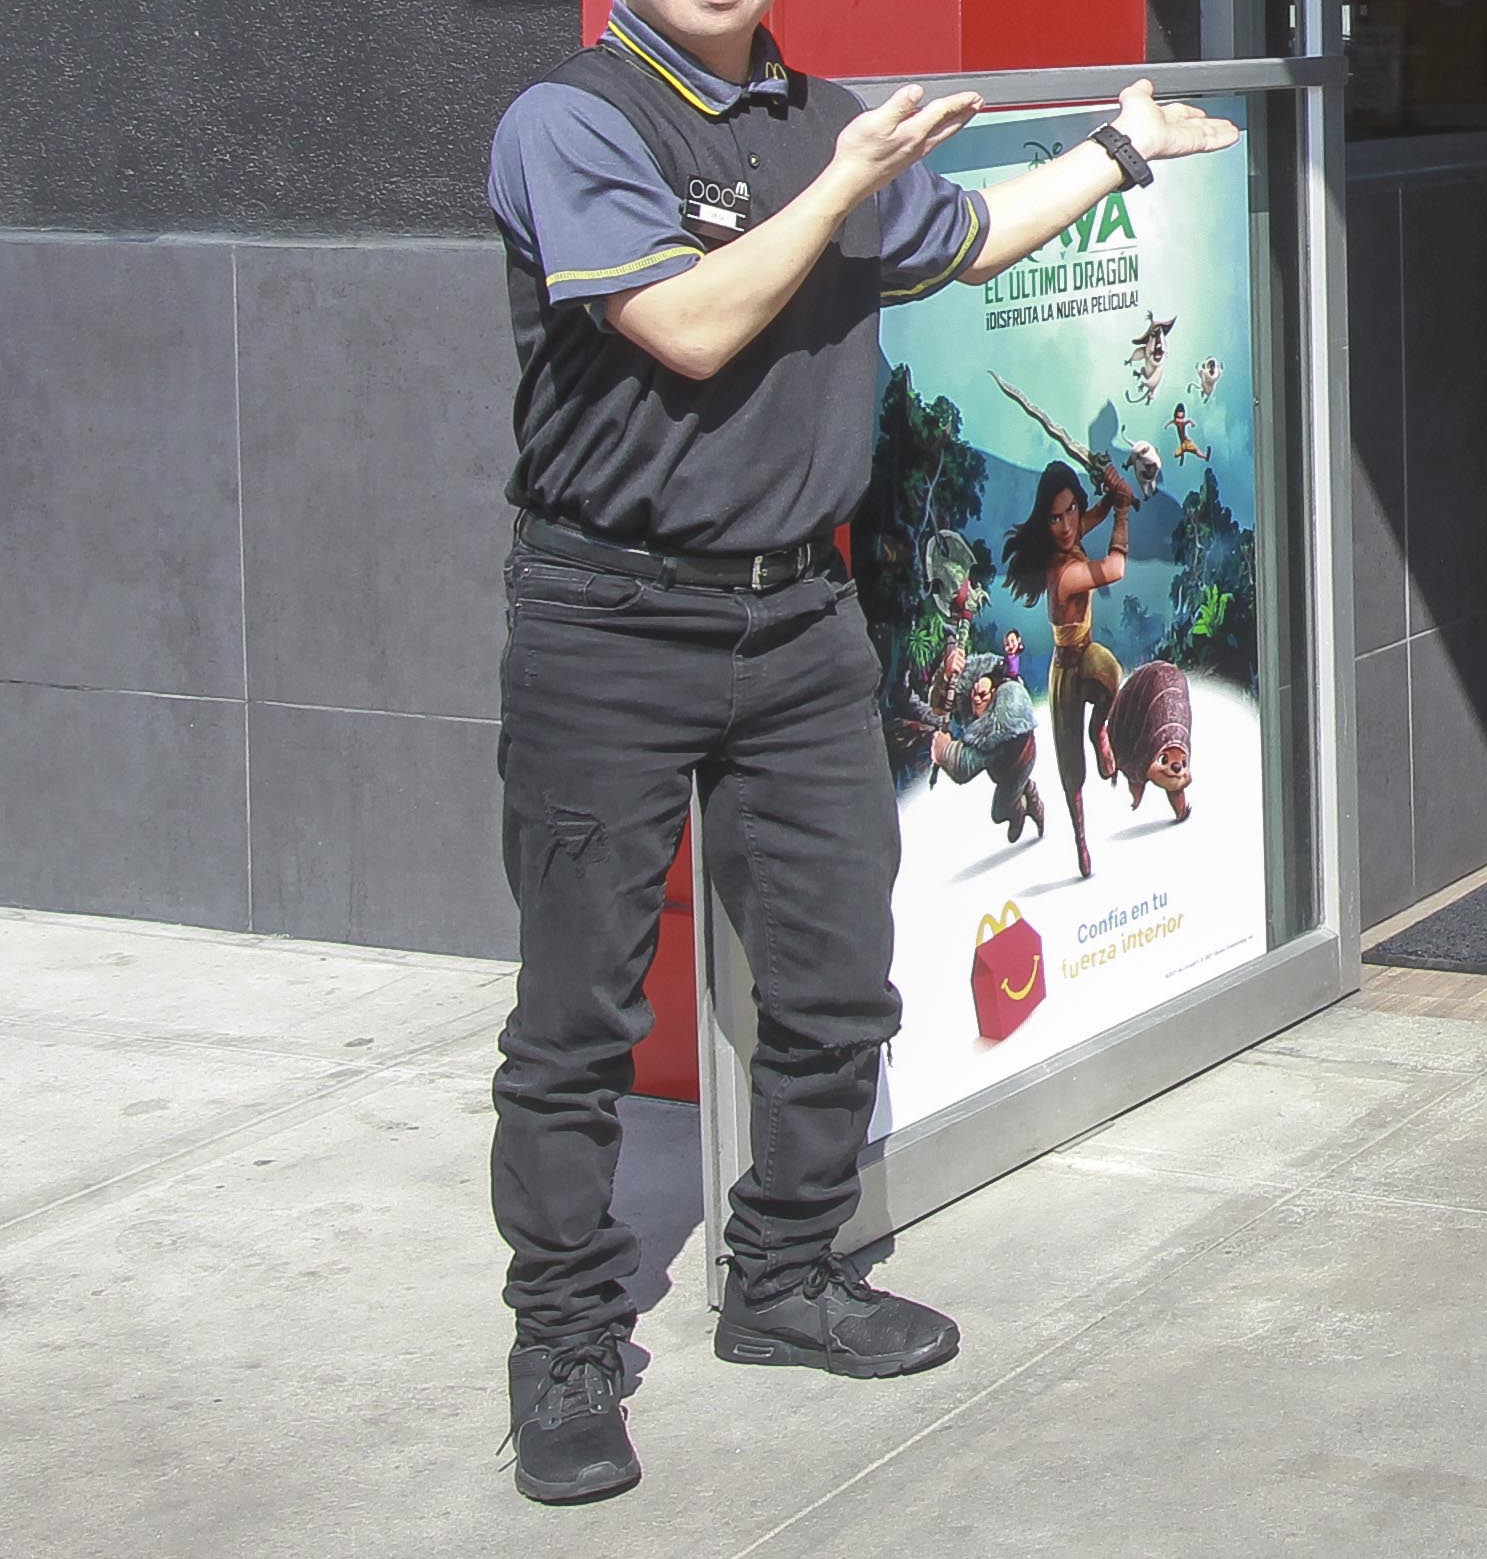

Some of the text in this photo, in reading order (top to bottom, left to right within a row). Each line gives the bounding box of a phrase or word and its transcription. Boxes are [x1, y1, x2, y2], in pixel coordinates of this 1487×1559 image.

[984, 250, 1139, 305] EL ÚLTIMO DRAGÓN
[1041, 302, 1054, 323] LA
[1056, 298, 1089, 320] NUEVA
[1077, 892, 1168, 944] Confía en tu
[1061, 943, 1117, 980] fuerza
[1120, 913, 1184, 954] interior
